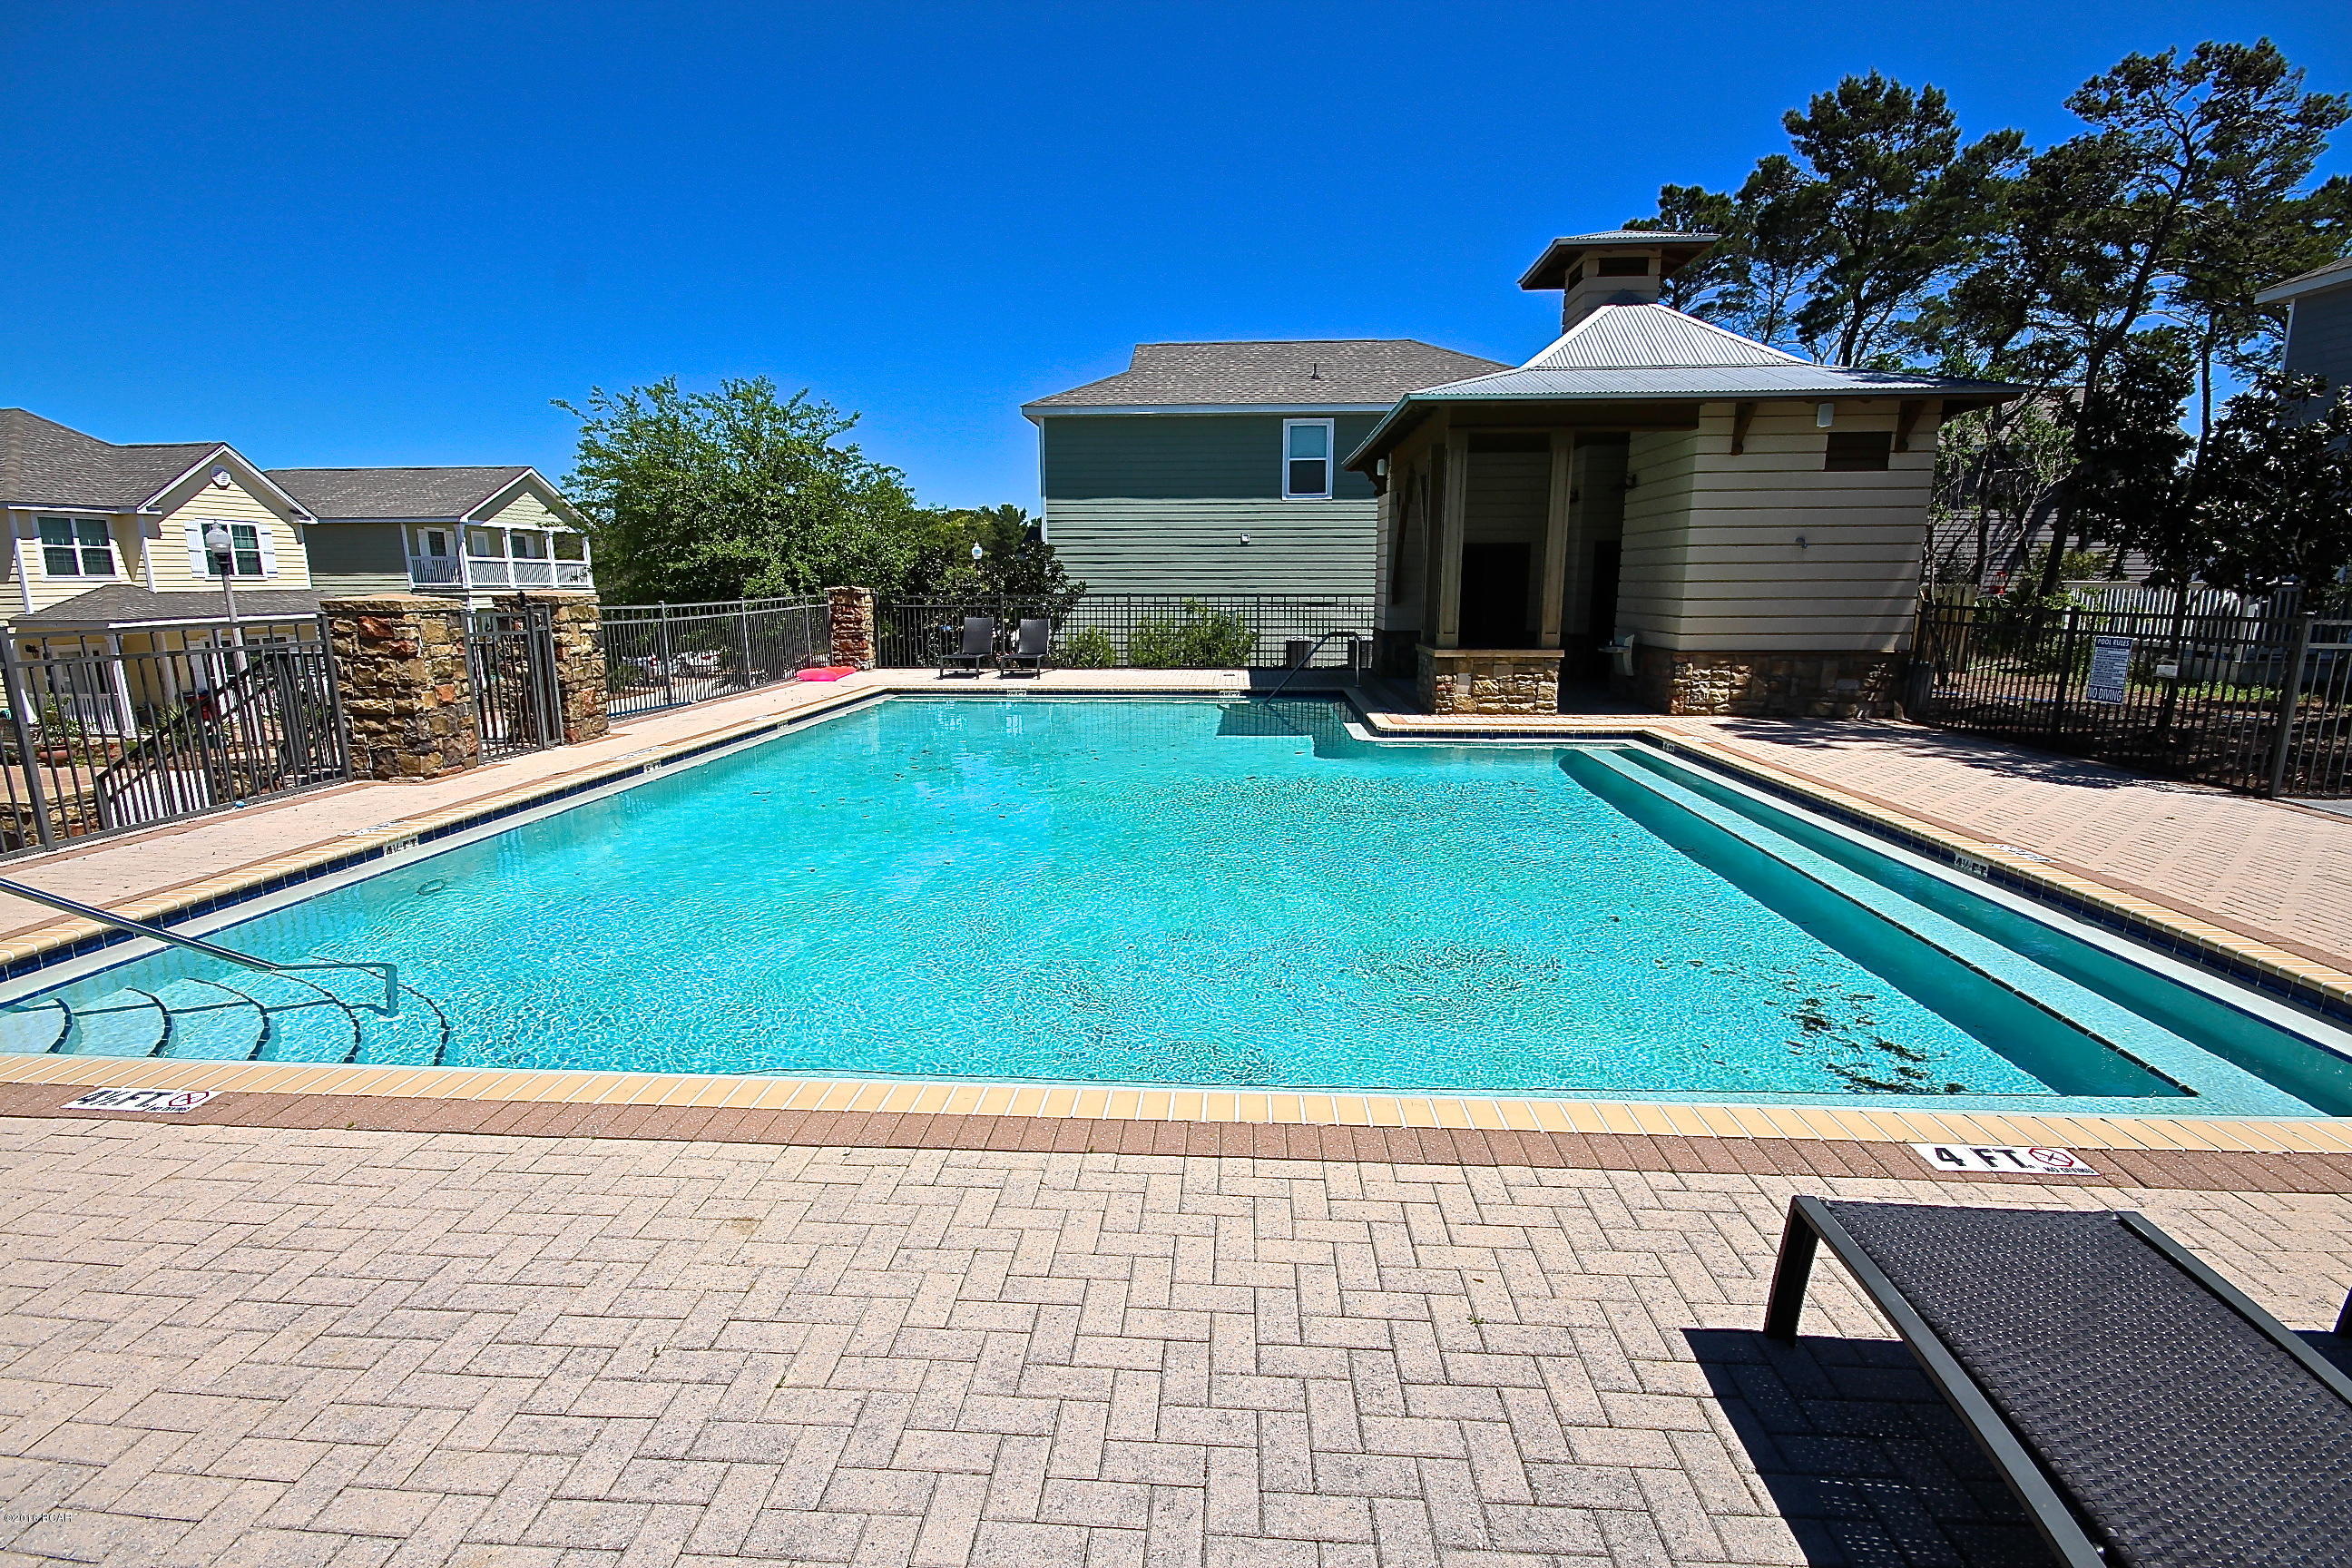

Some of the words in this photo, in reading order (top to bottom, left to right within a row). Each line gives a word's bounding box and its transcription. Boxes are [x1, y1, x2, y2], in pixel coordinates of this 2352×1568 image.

[2097, 638, 2112, 646] POOL
[2112, 639, 2131, 647] RULES
[2087, 686, 2098, 699] NO
[2098, 688, 2122, 702] DIVING
[1934, 1147, 1967, 1167] 4
